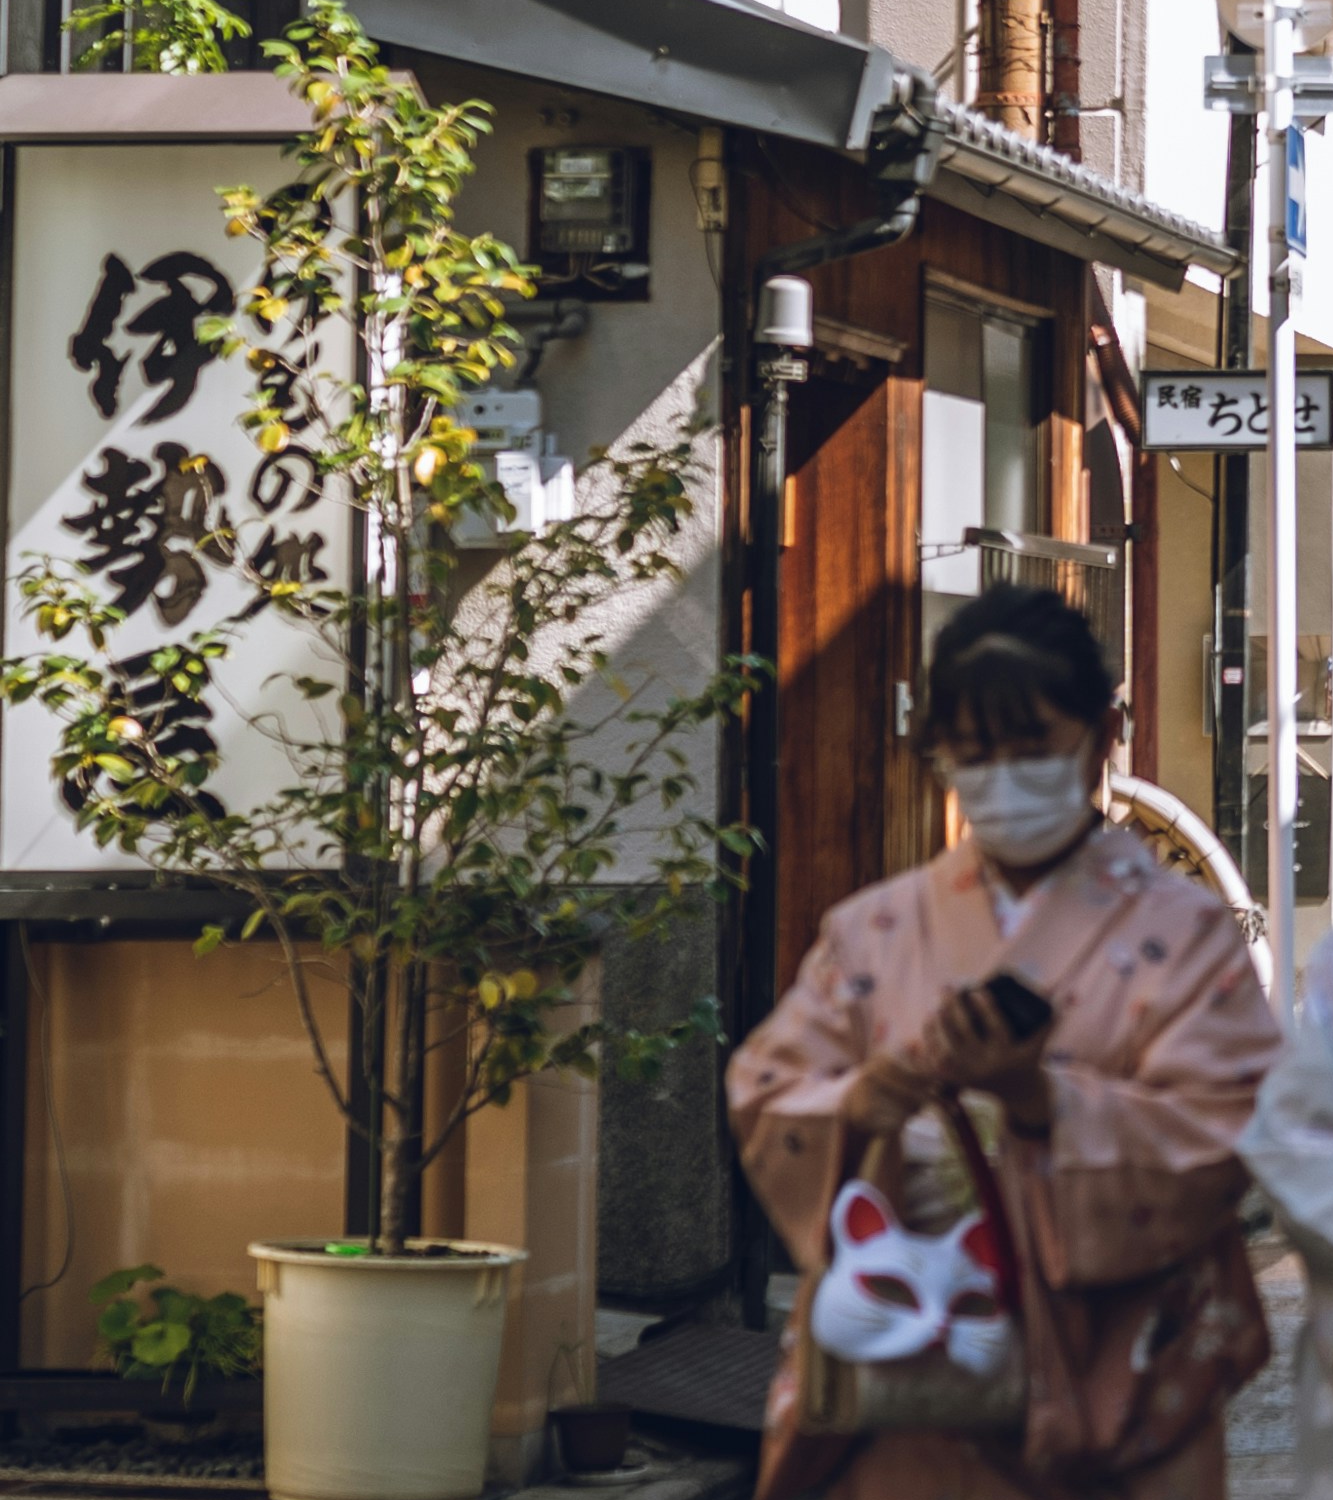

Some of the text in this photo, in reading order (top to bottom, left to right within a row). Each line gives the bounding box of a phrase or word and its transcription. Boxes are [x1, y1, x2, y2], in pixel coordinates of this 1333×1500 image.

[1157, 384, 1320, 437] 民宿 ちとせ
